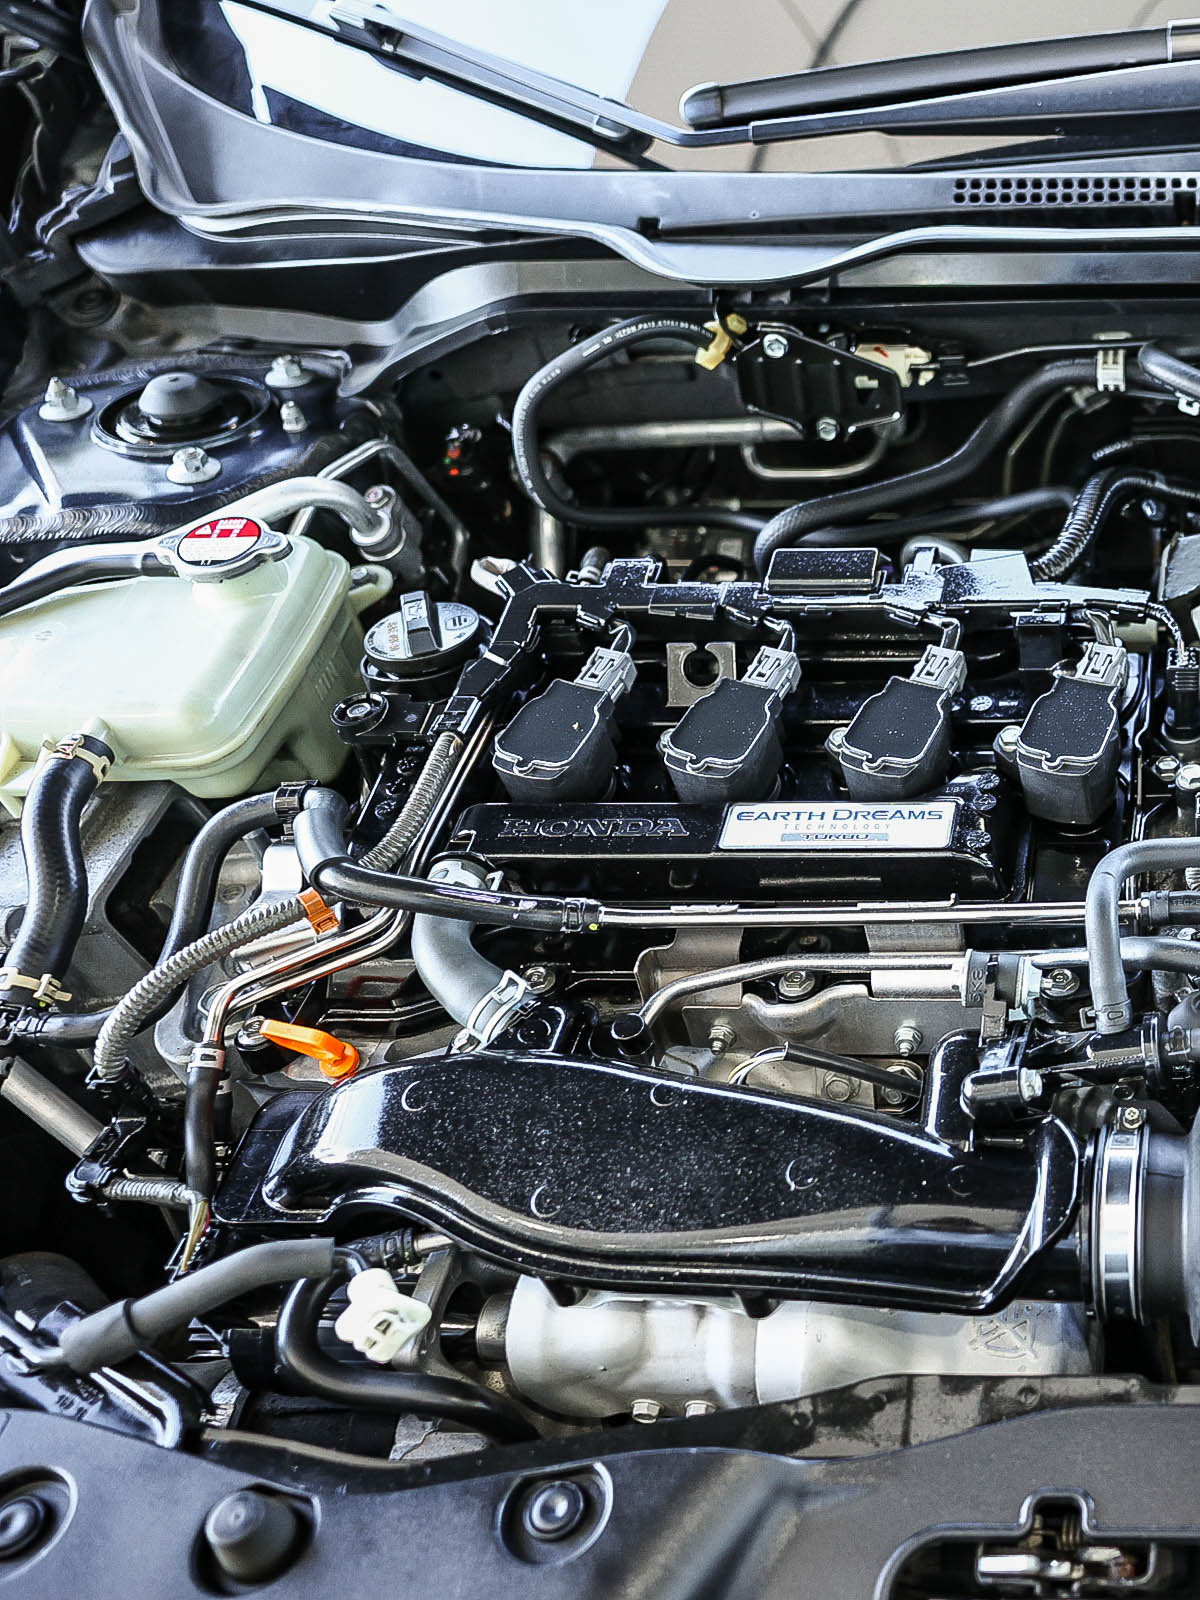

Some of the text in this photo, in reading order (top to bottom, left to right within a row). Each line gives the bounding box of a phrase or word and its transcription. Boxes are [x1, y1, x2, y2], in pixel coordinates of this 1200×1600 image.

[736, 809, 944, 821] EARTH DREAMS
[497, 818, 691, 838] HONDA
[783, 823, 891, 831] TECHNOLOGY
[802, 833, 870, 841] TURBO
